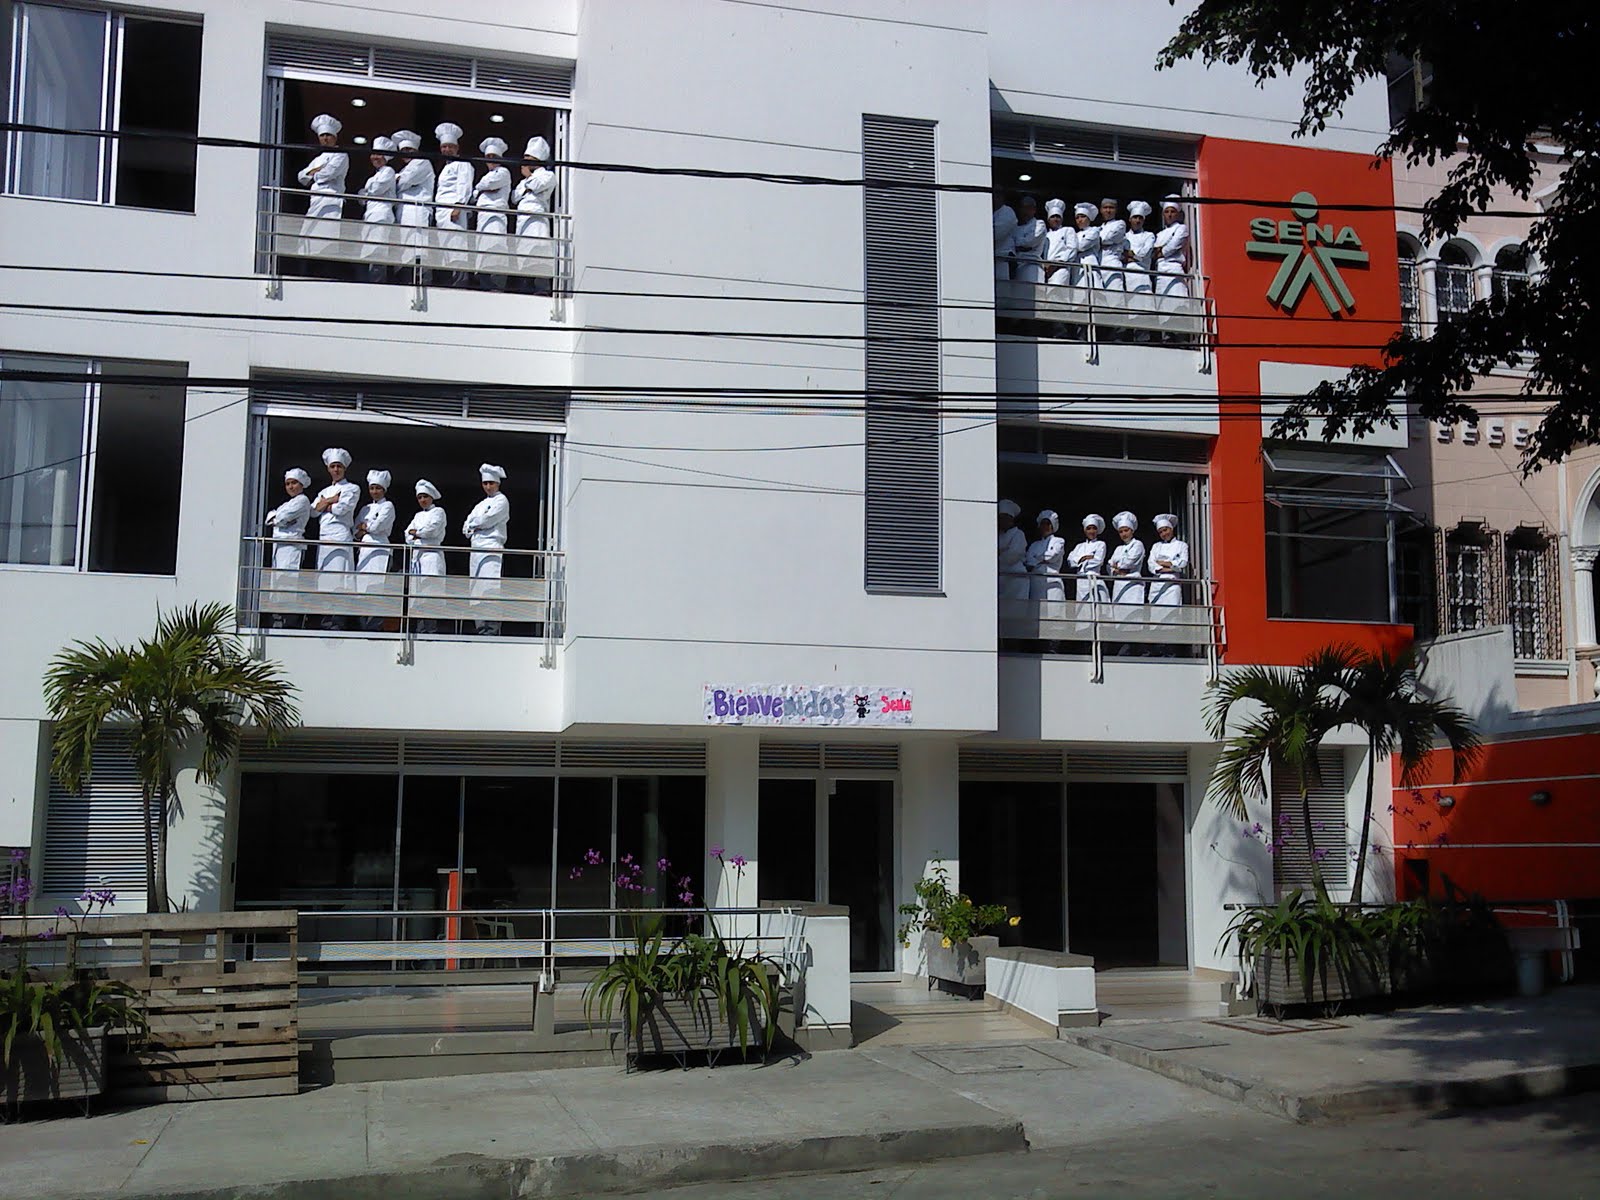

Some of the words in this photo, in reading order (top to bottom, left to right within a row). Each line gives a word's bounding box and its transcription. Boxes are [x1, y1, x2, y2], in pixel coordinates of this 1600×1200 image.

[1250, 217, 1363, 247] SENA
[713, 689, 846, 720] Bienvenidos
[881, 695, 911, 713] Sena
